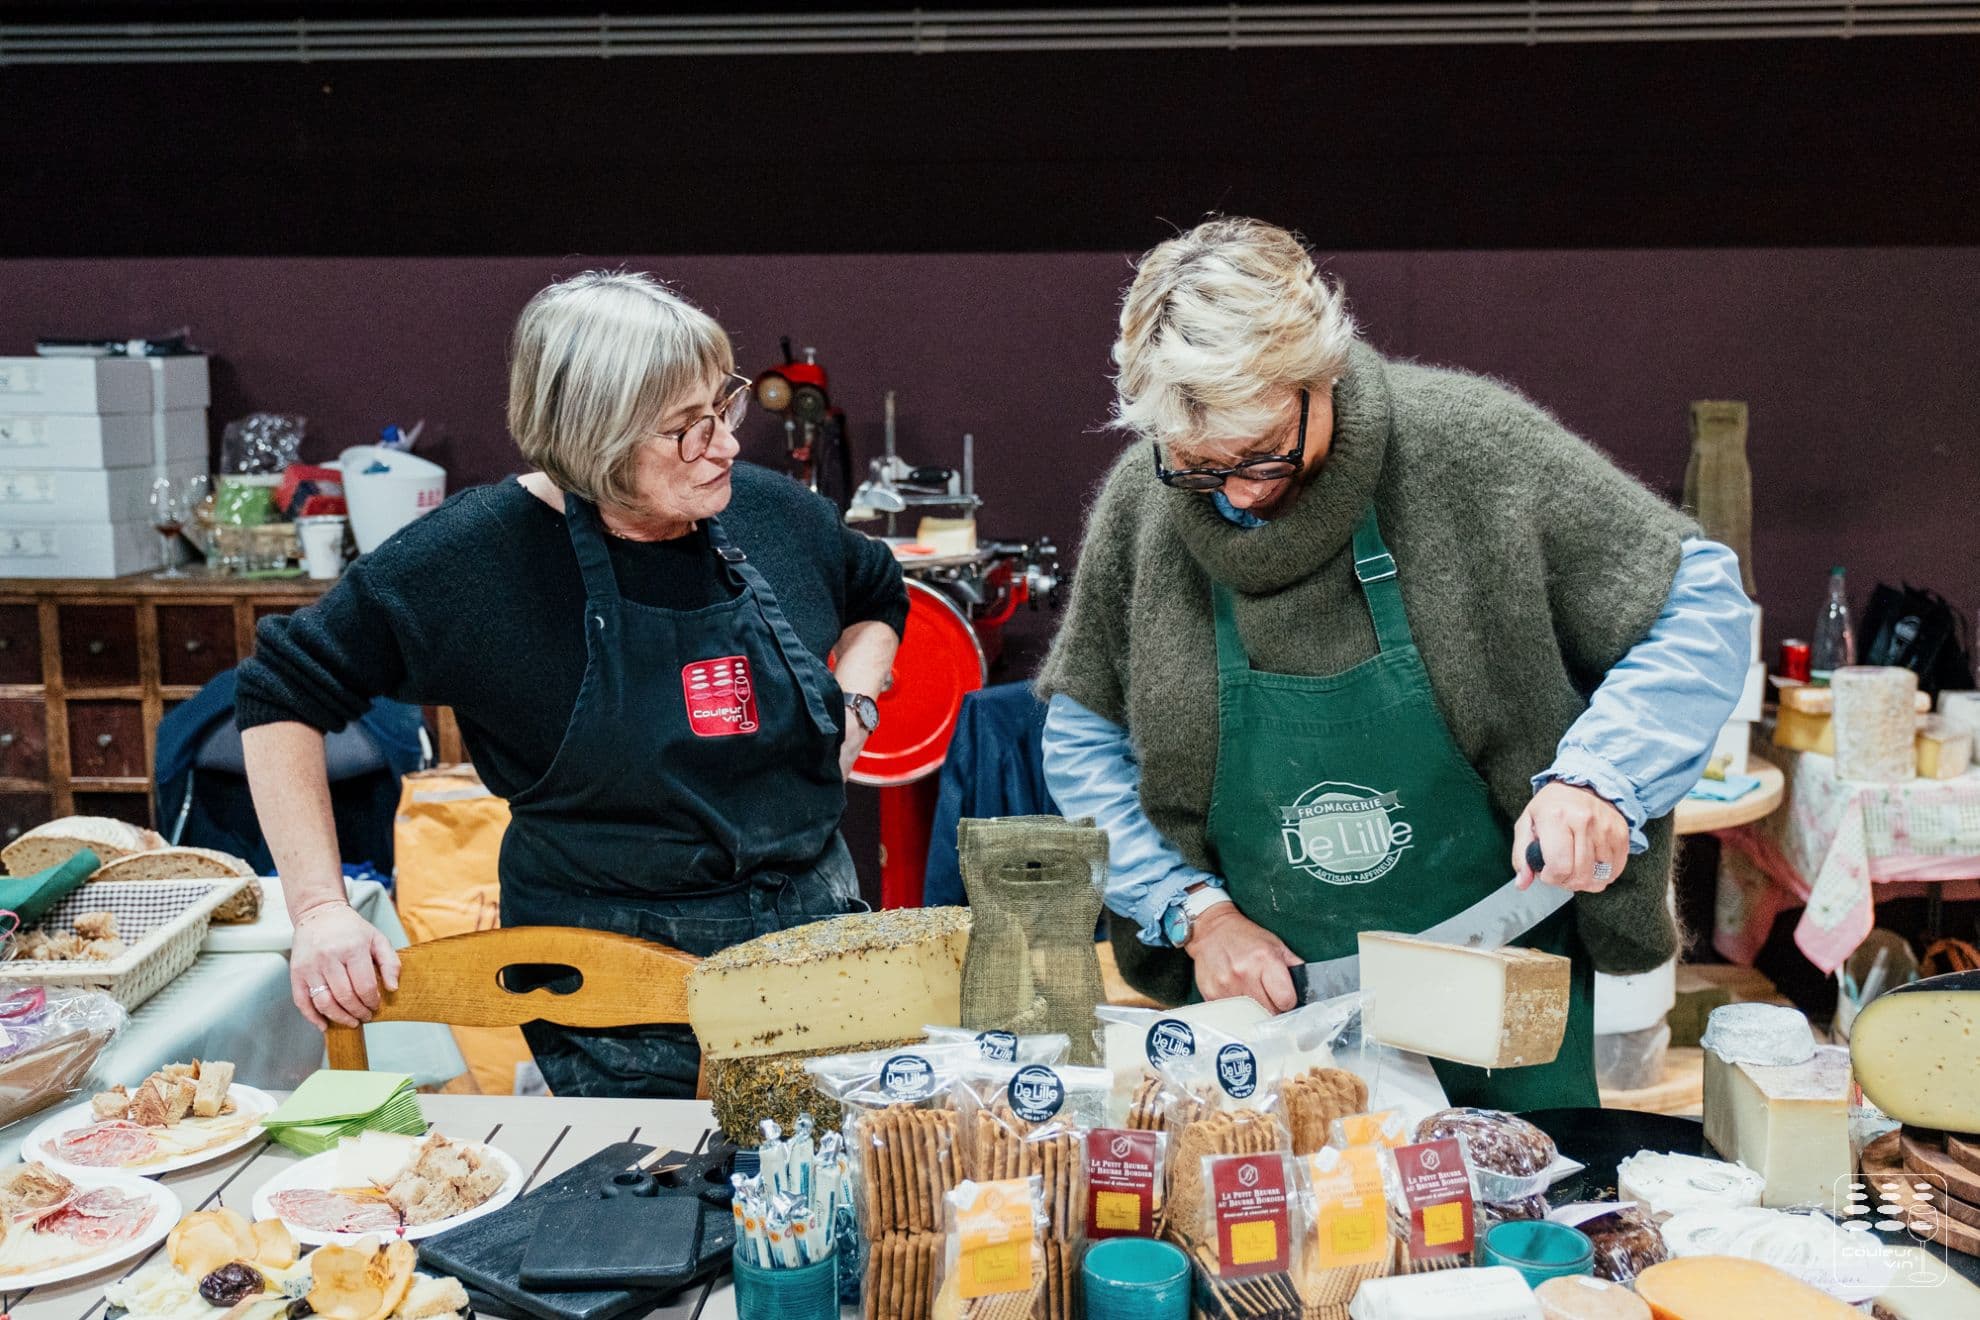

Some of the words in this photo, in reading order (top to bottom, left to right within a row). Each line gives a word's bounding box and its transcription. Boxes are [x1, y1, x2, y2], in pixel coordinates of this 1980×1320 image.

[1297, 797, 1383, 818] FROMAGERIE
[1281, 828, 1334, 864] De
[1337, 817, 1413, 856] Lille
[1314, 868, 1352, 882] ARTISAN
[1359, 855, 1396, 881] AFFINEUR
[1152, 1031, 1168, 1050] De
[1168, 1037, 1190, 1057] Lille
[1014, 1082, 1031, 1098] De
[1032, 1083, 1058, 1101] Lille
